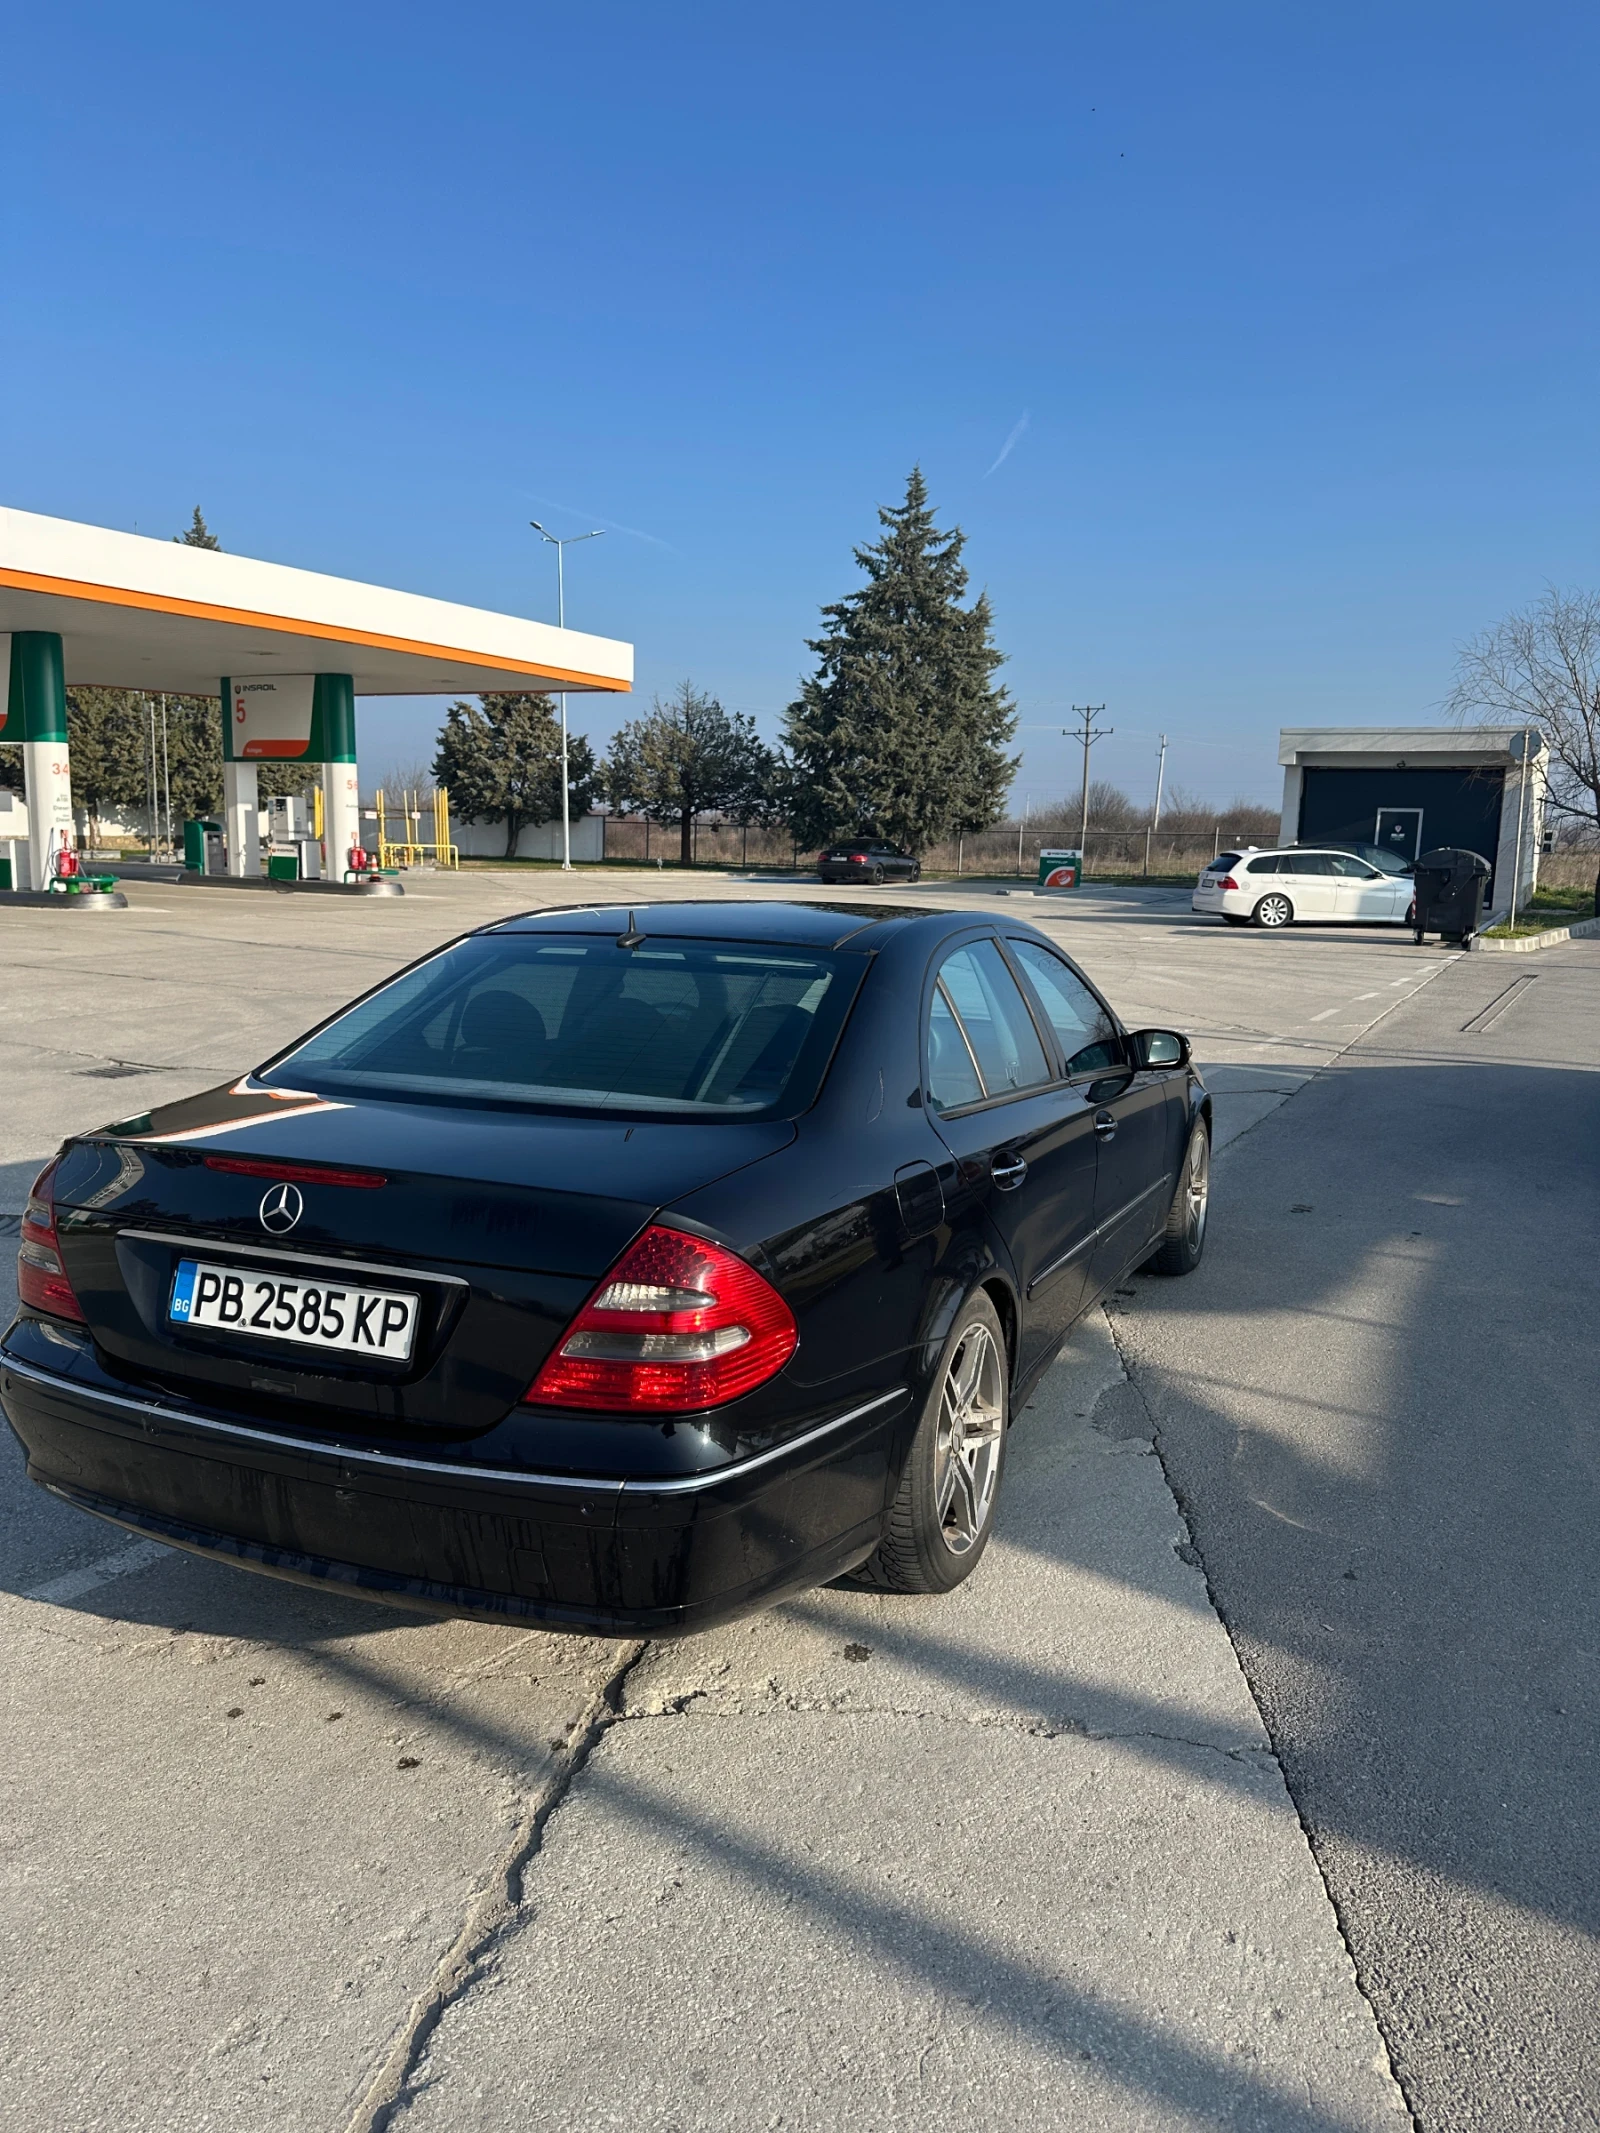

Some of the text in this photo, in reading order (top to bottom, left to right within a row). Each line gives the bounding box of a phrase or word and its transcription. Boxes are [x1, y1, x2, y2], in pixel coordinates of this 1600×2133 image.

[236, 699, 246, 723] 5
[174, 1298, 190, 1313] BG
[193, 1272, 409, 1347] PB 2585 KP
